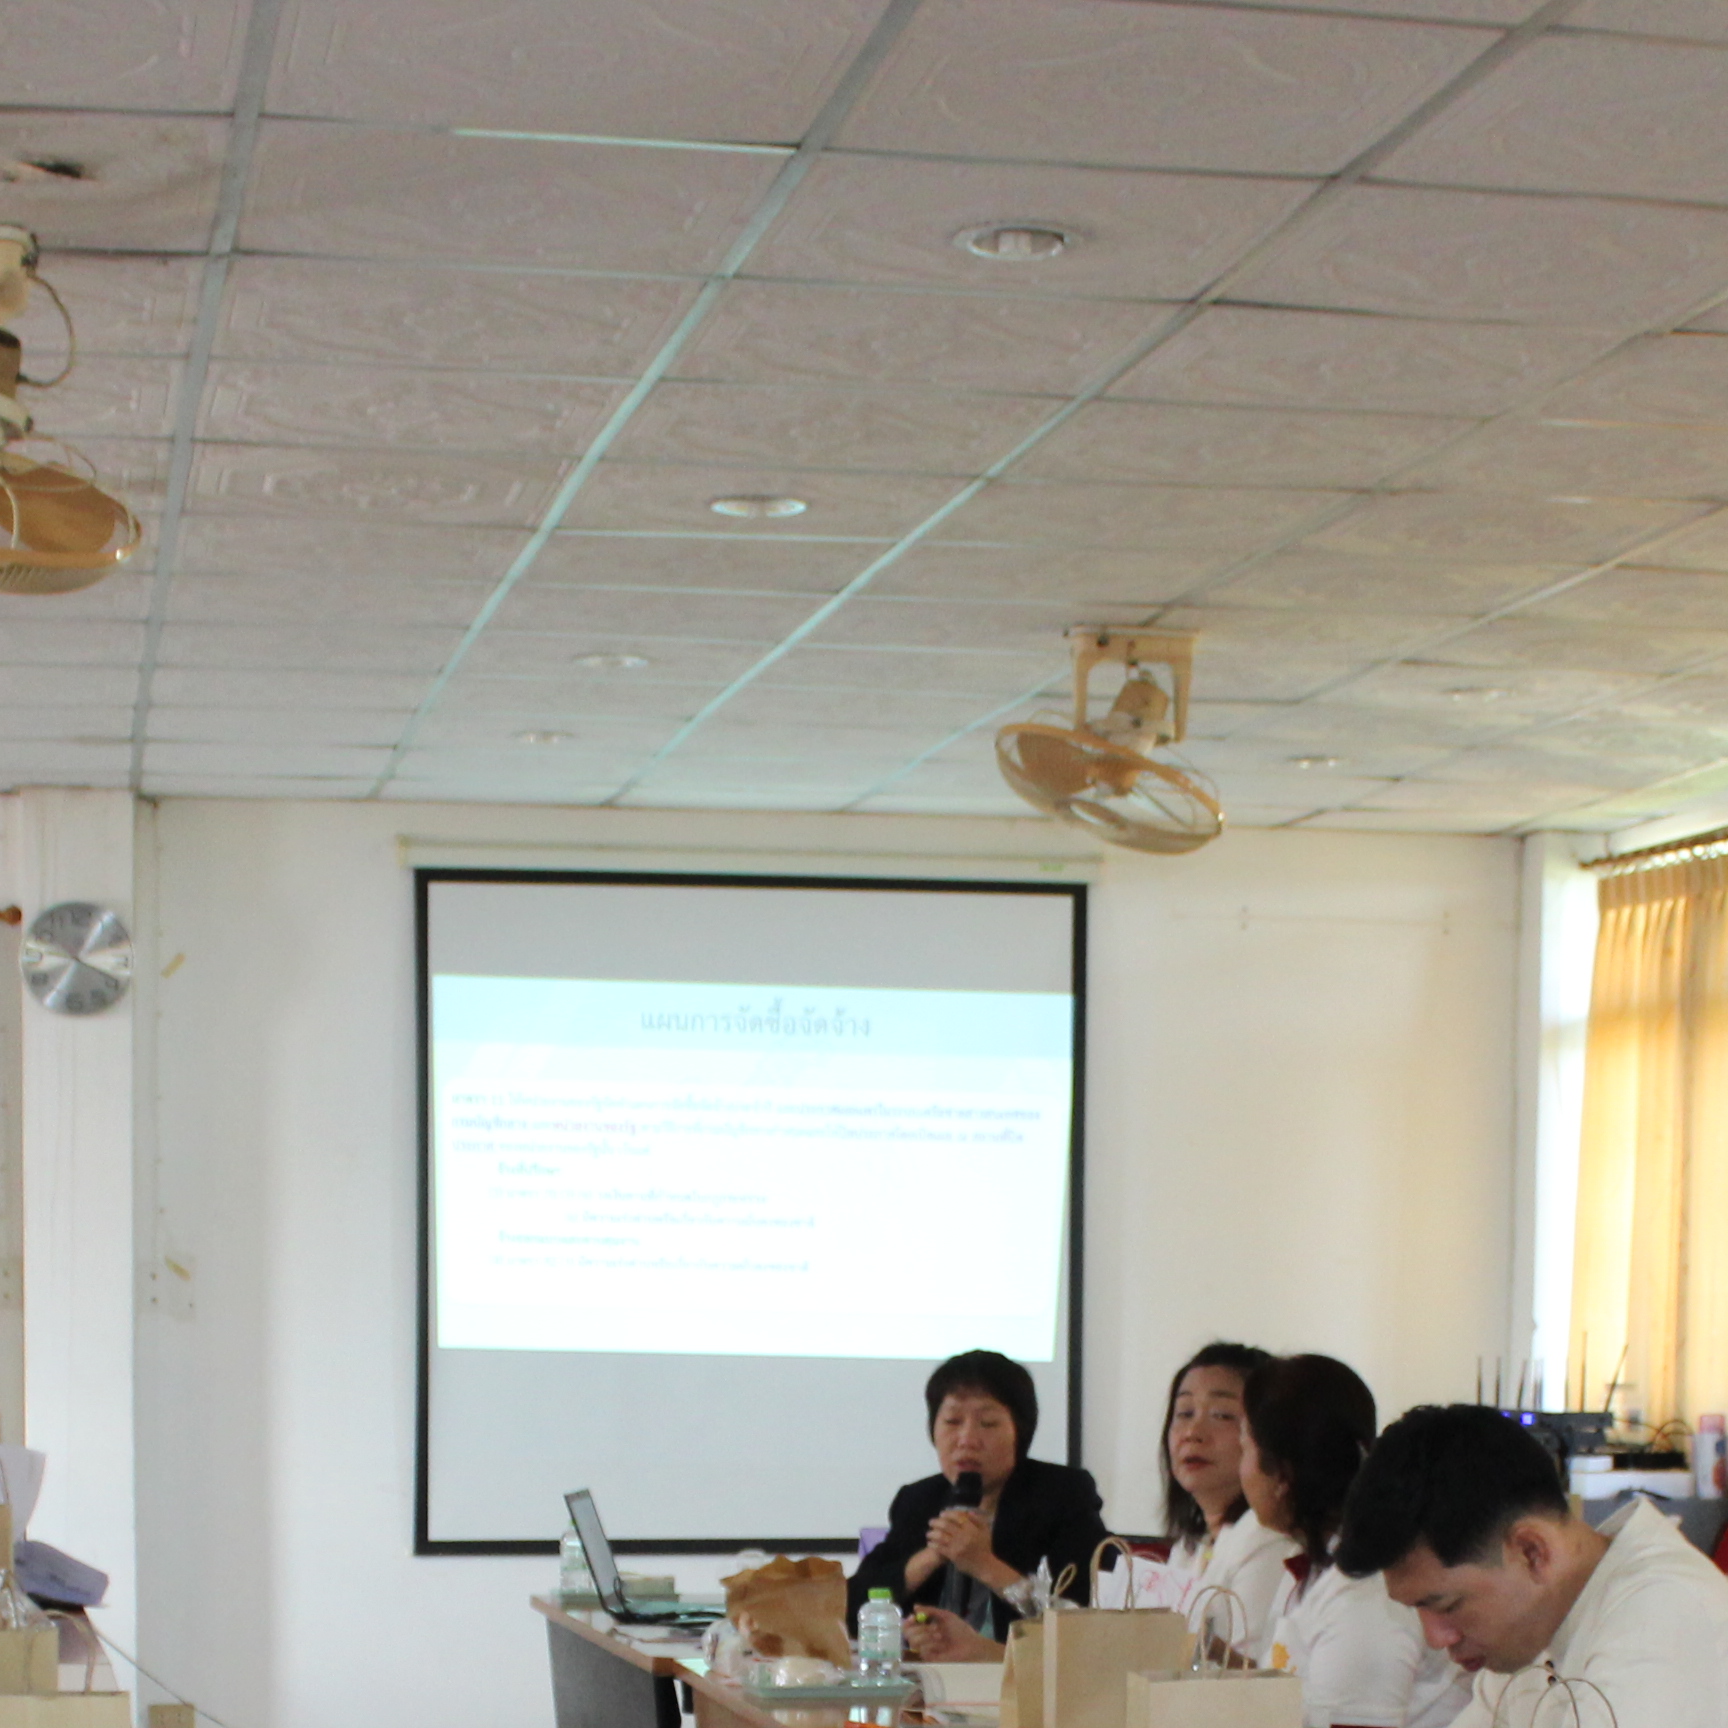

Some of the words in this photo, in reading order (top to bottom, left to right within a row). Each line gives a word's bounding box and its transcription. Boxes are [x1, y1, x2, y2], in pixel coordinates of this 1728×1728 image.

[639, 996, 872, 1037] แผนการจัดซื้อจัดจ้าง
